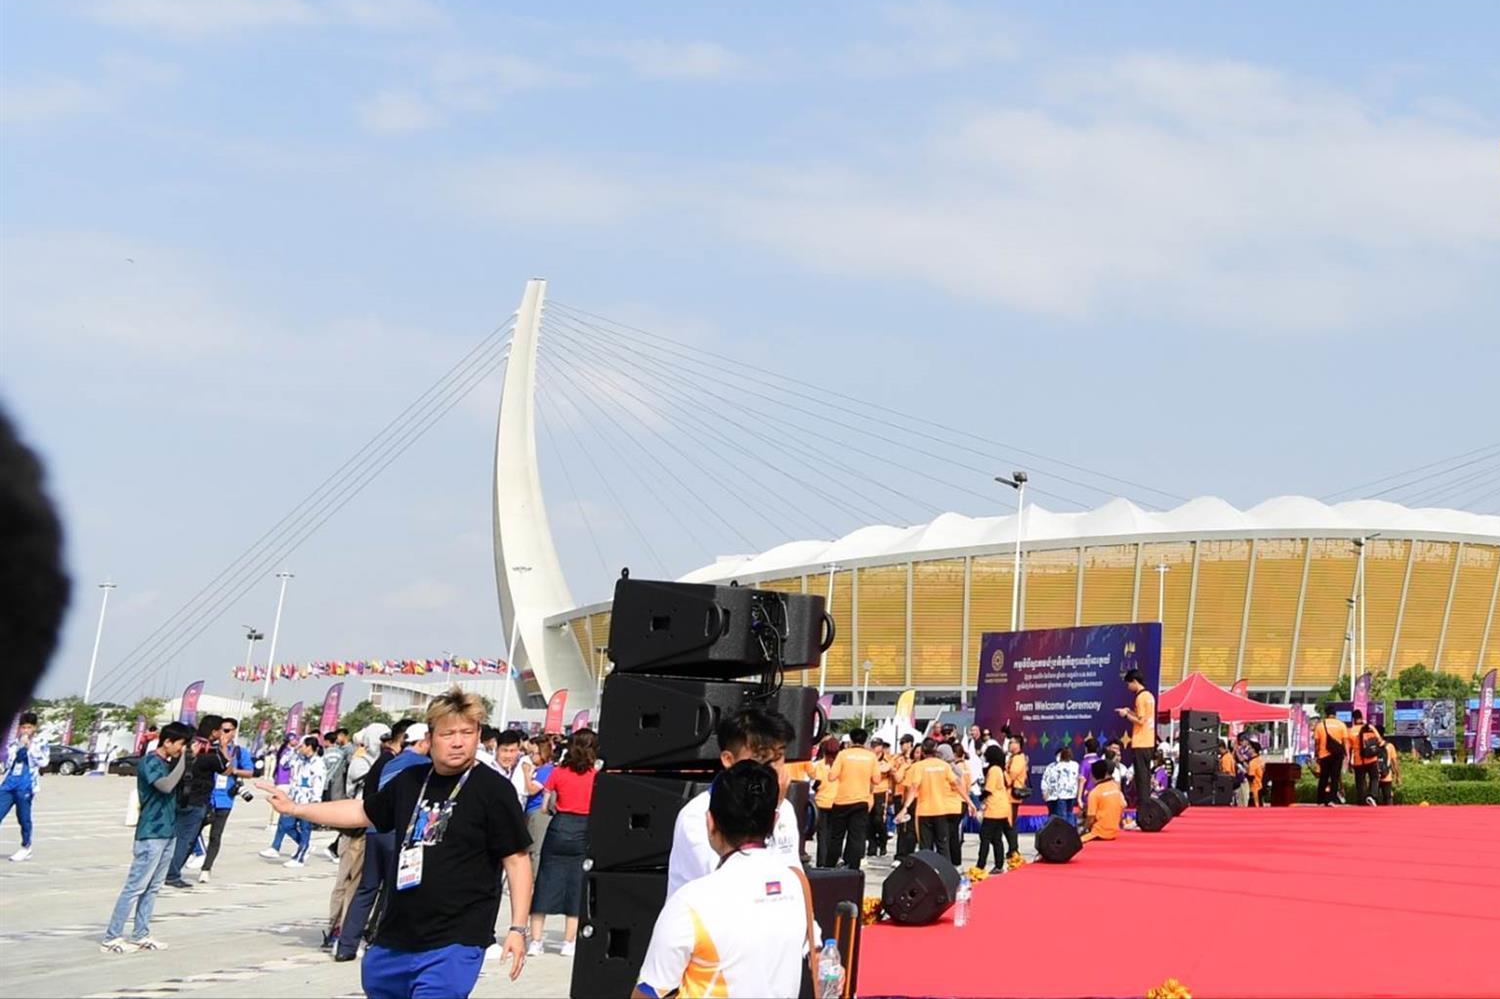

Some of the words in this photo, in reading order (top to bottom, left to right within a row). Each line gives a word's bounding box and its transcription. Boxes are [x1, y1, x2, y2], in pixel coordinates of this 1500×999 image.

[1015, 700, 1033, 711] Team
[1034, 700, 1065, 711] Welcome
[1066, 700, 1102, 712] Ceremony
